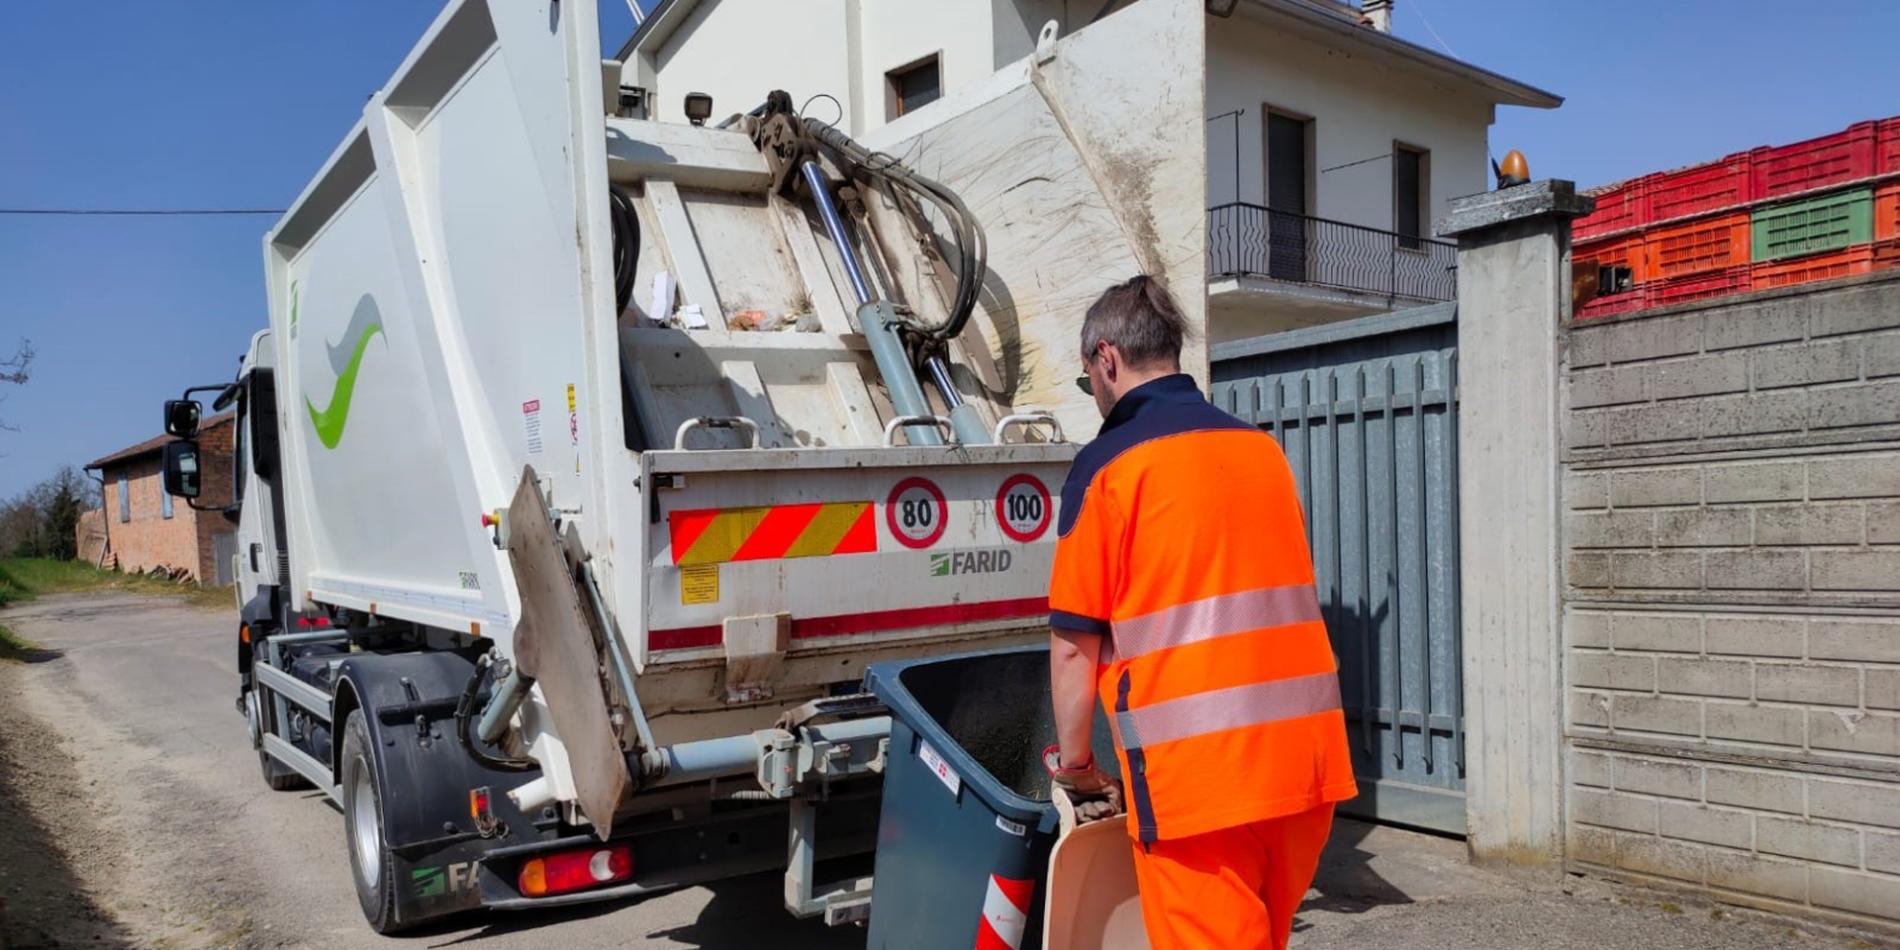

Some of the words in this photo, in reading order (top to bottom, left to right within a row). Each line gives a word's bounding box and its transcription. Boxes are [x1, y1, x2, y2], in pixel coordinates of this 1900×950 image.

[903, 499, 931, 528] 80
[1007, 494, 1042, 521] 100
[952, 550, 1012, 575] FARID
